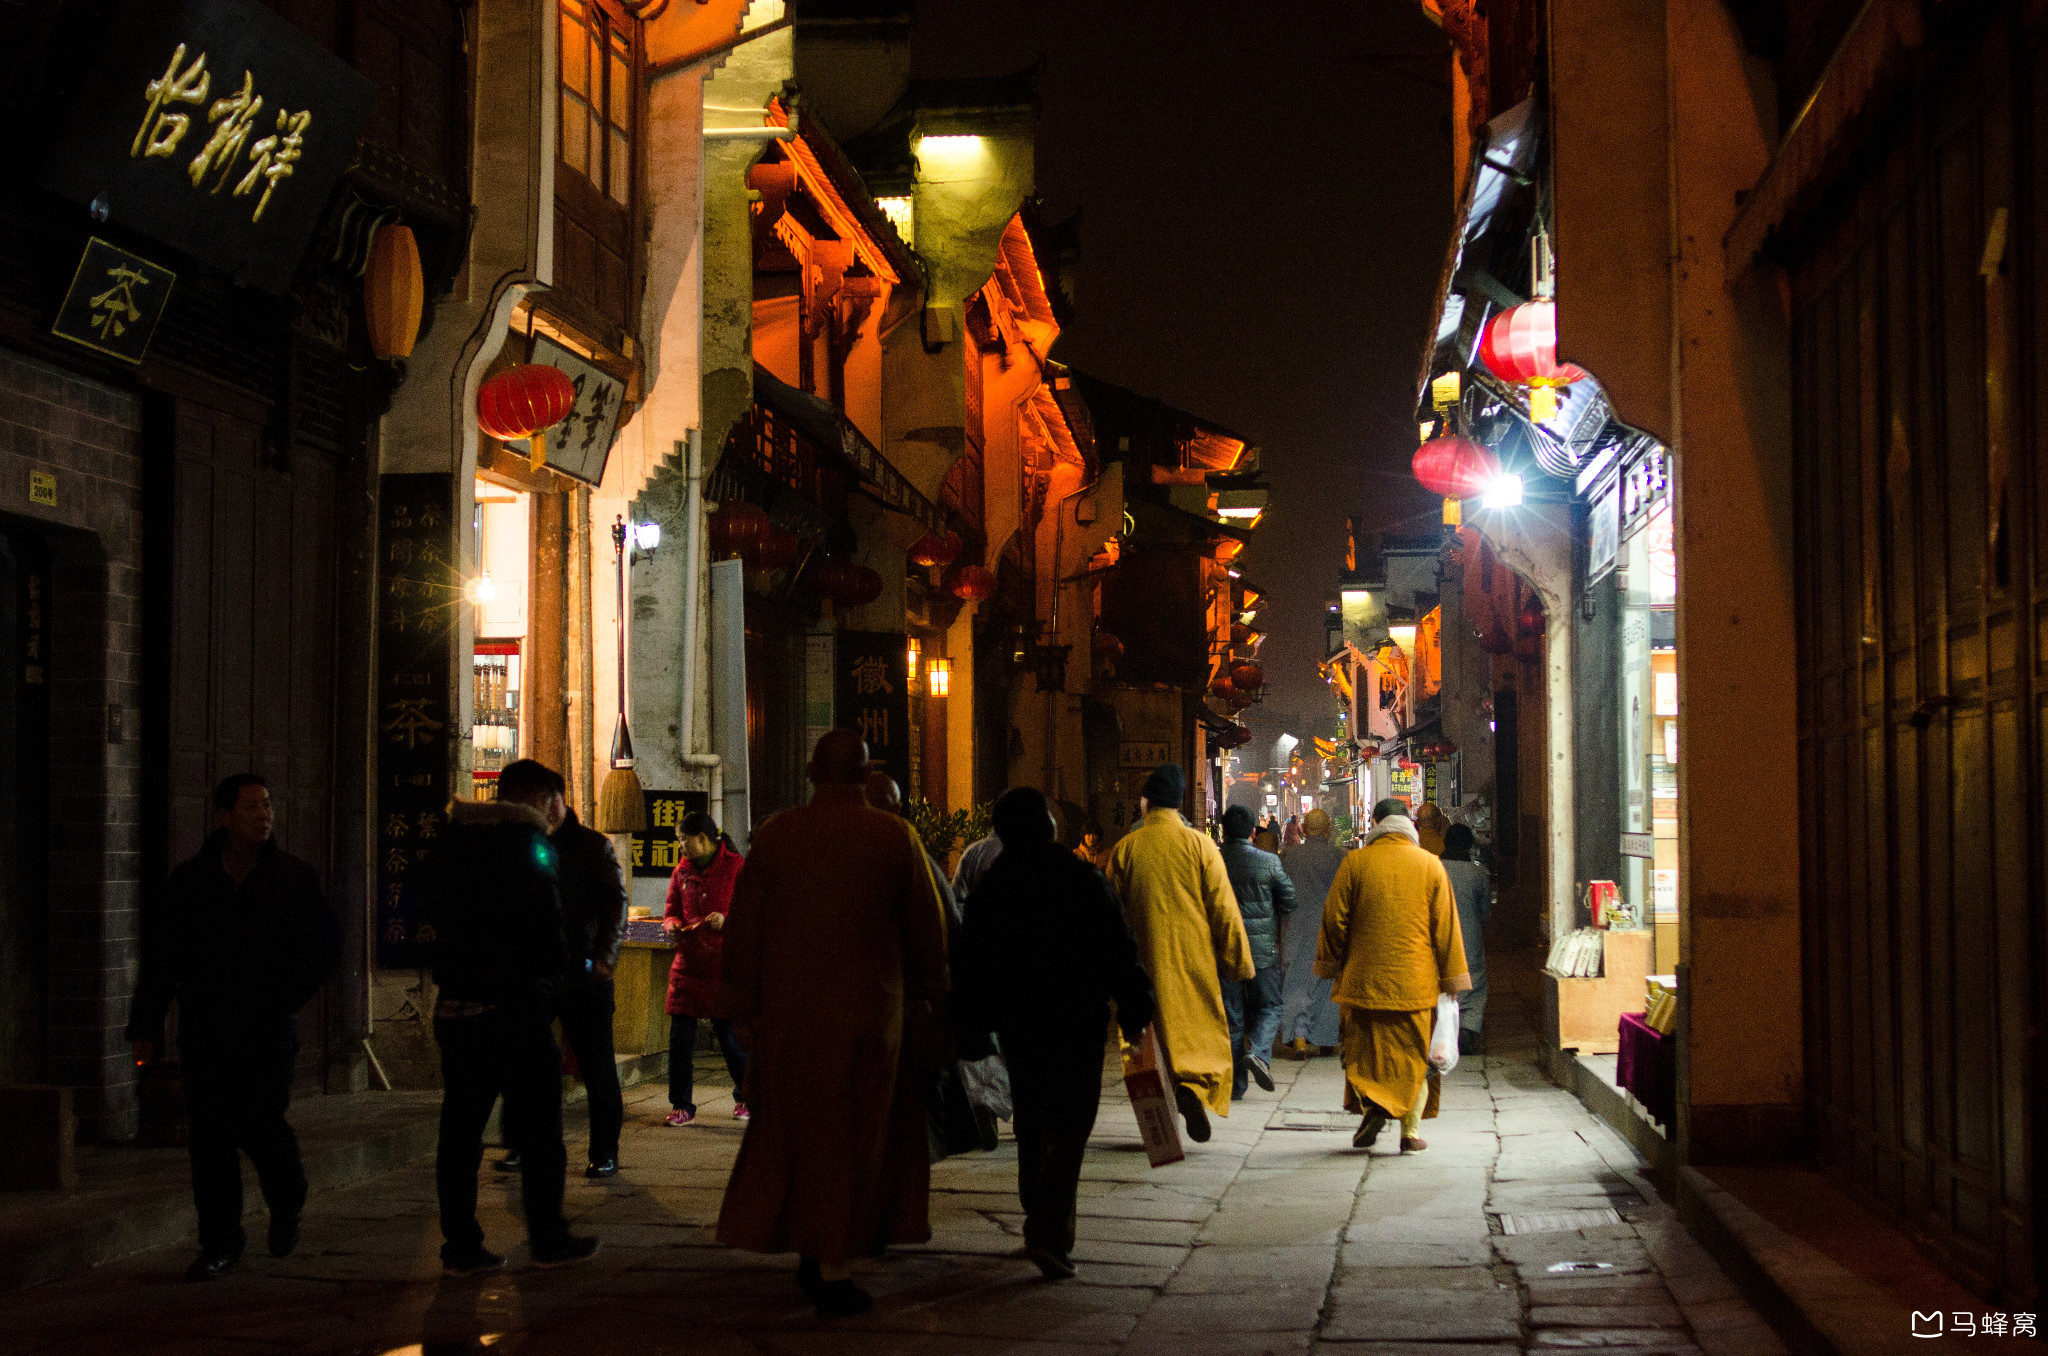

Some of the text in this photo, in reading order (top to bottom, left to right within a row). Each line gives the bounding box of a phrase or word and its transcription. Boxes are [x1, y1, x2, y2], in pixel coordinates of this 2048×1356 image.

[89, 263, 149, 340] 茶
[380, 697, 443, 750] 茶
[851, 655, 895, 768] 徽州
[652, 798, 685, 827] 街
